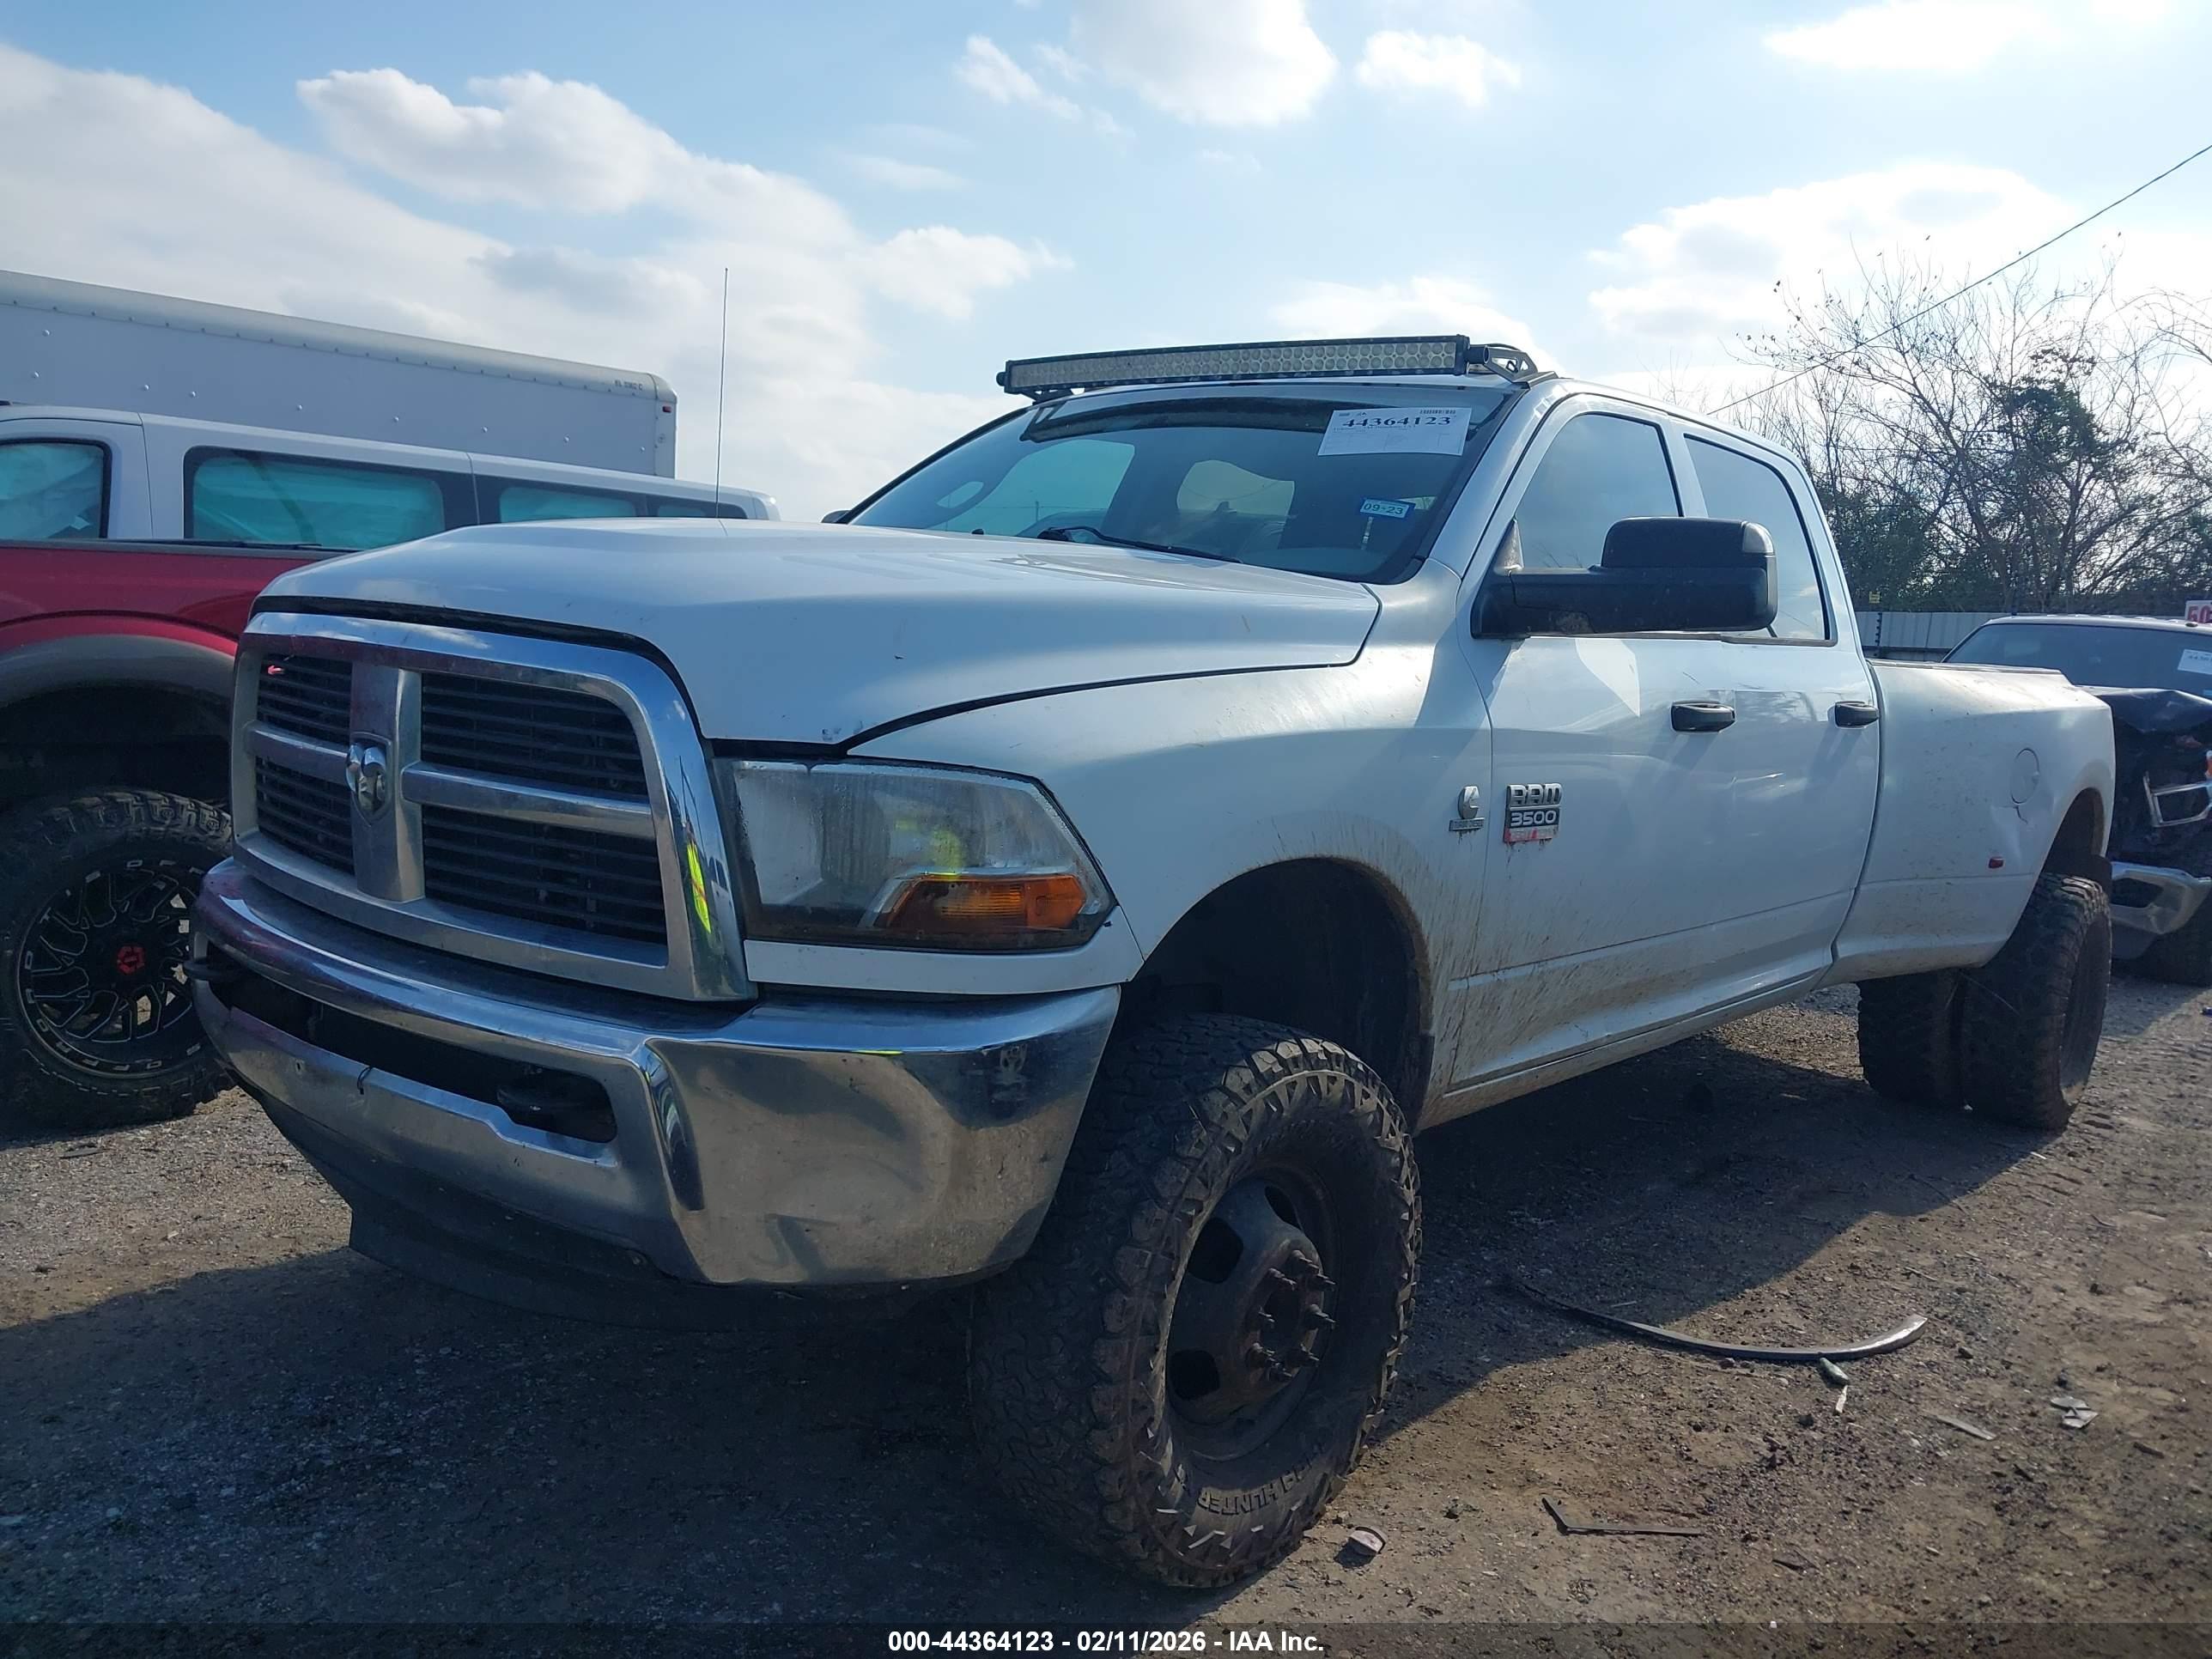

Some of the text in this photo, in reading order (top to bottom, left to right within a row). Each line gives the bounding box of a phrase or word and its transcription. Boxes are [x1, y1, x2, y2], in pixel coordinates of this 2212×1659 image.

[1342, 416, 1452, 428] 44364123
[1507, 783, 1564, 806] RAM
[1510, 809, 1558, 827] 3500
